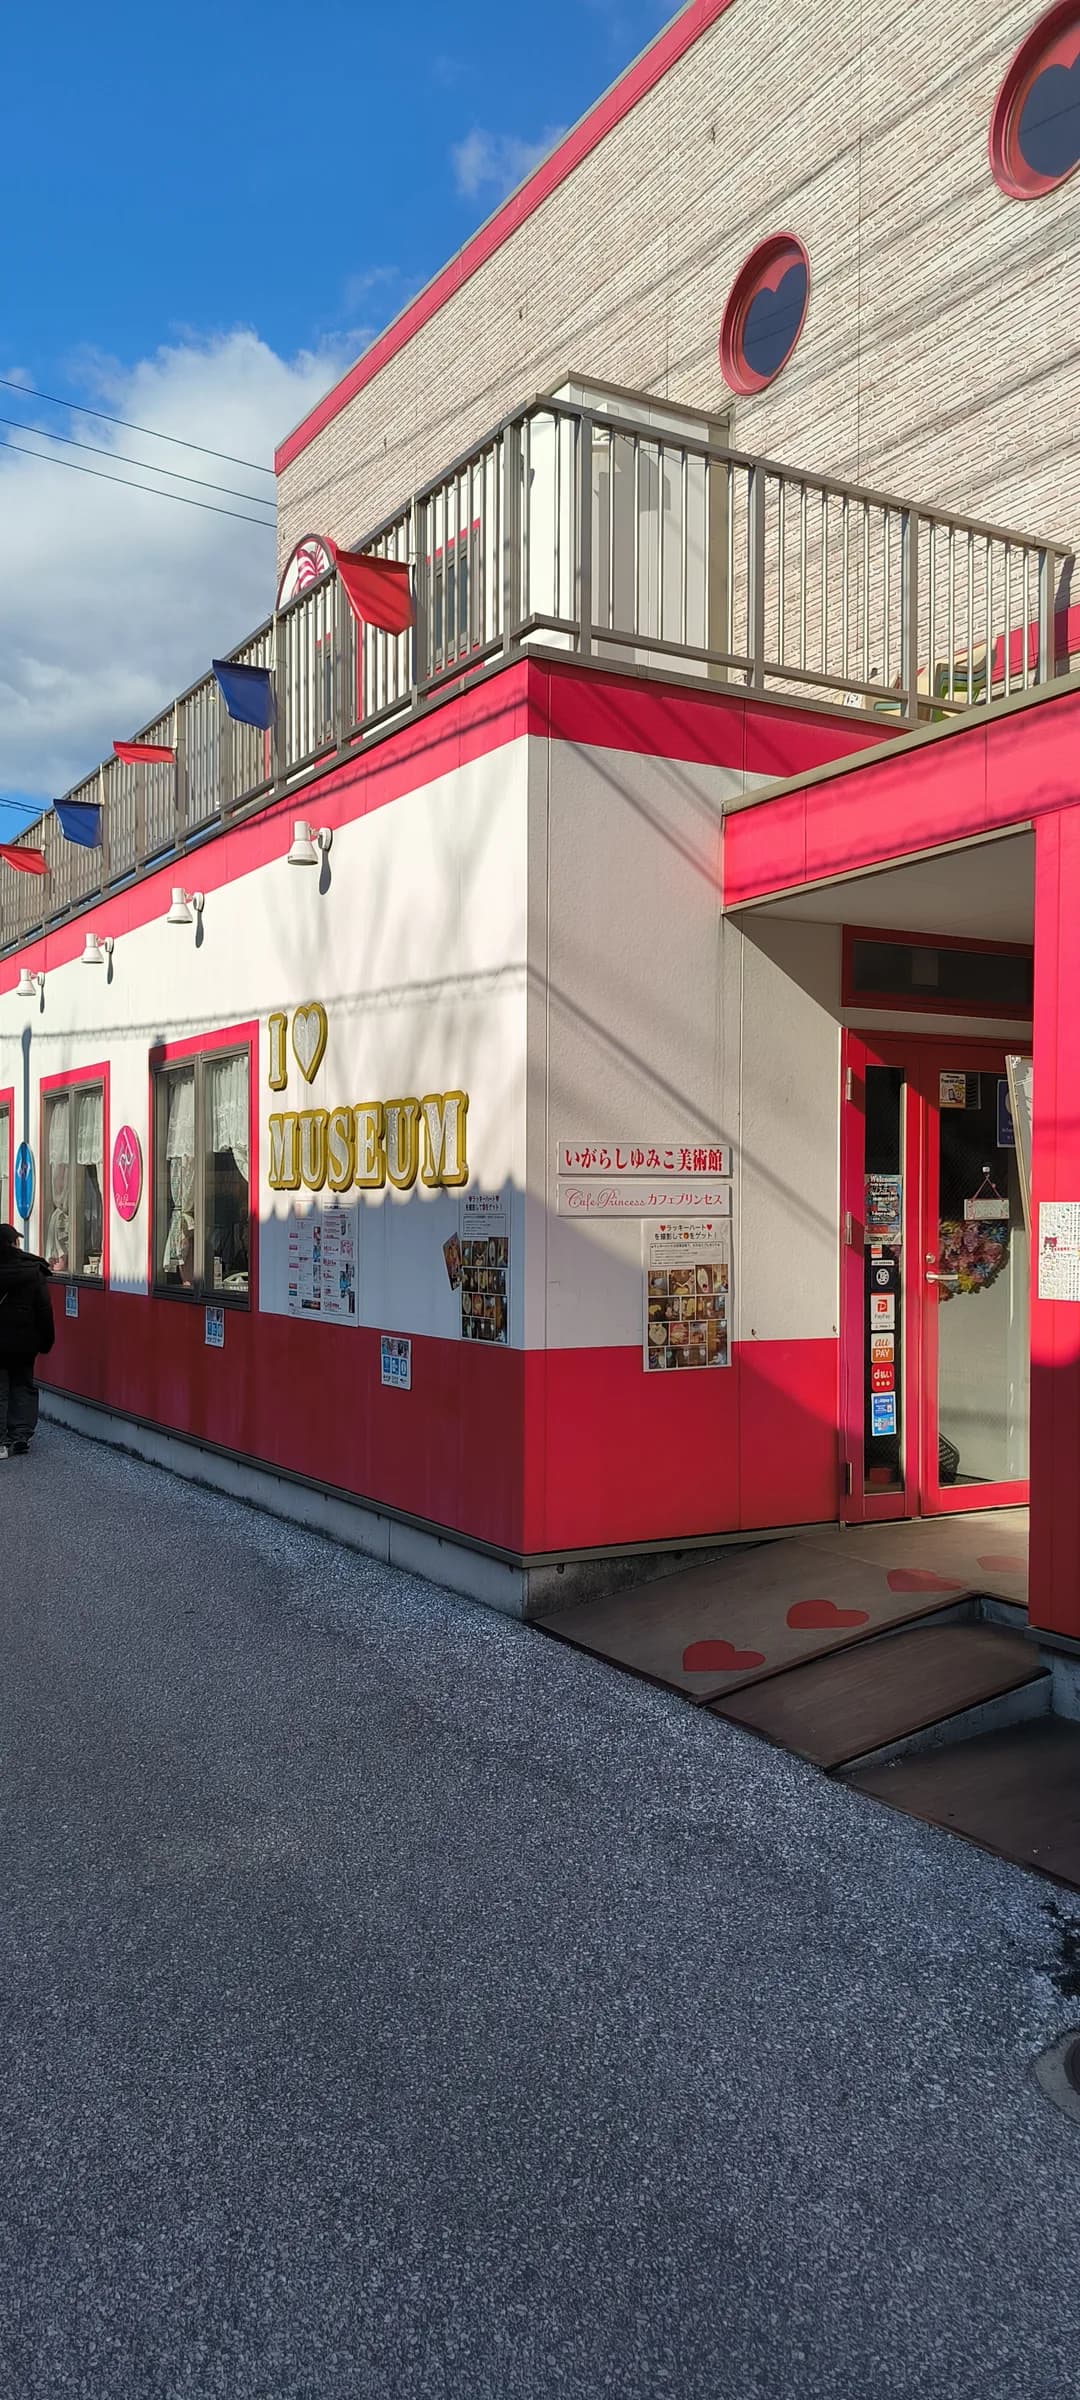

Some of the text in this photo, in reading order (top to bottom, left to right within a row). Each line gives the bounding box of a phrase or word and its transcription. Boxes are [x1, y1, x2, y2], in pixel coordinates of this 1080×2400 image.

[268, 1090, 470, 1192] MUSEUM
[564, 1147, 723, 1172] いがらしゆみこ美術館
[565, 1187, 723, 1211] Cafe Princess カフェプリンセス
[875, 1338, 889, 1347] au
[875, 1349, 890, 1358] PAY
